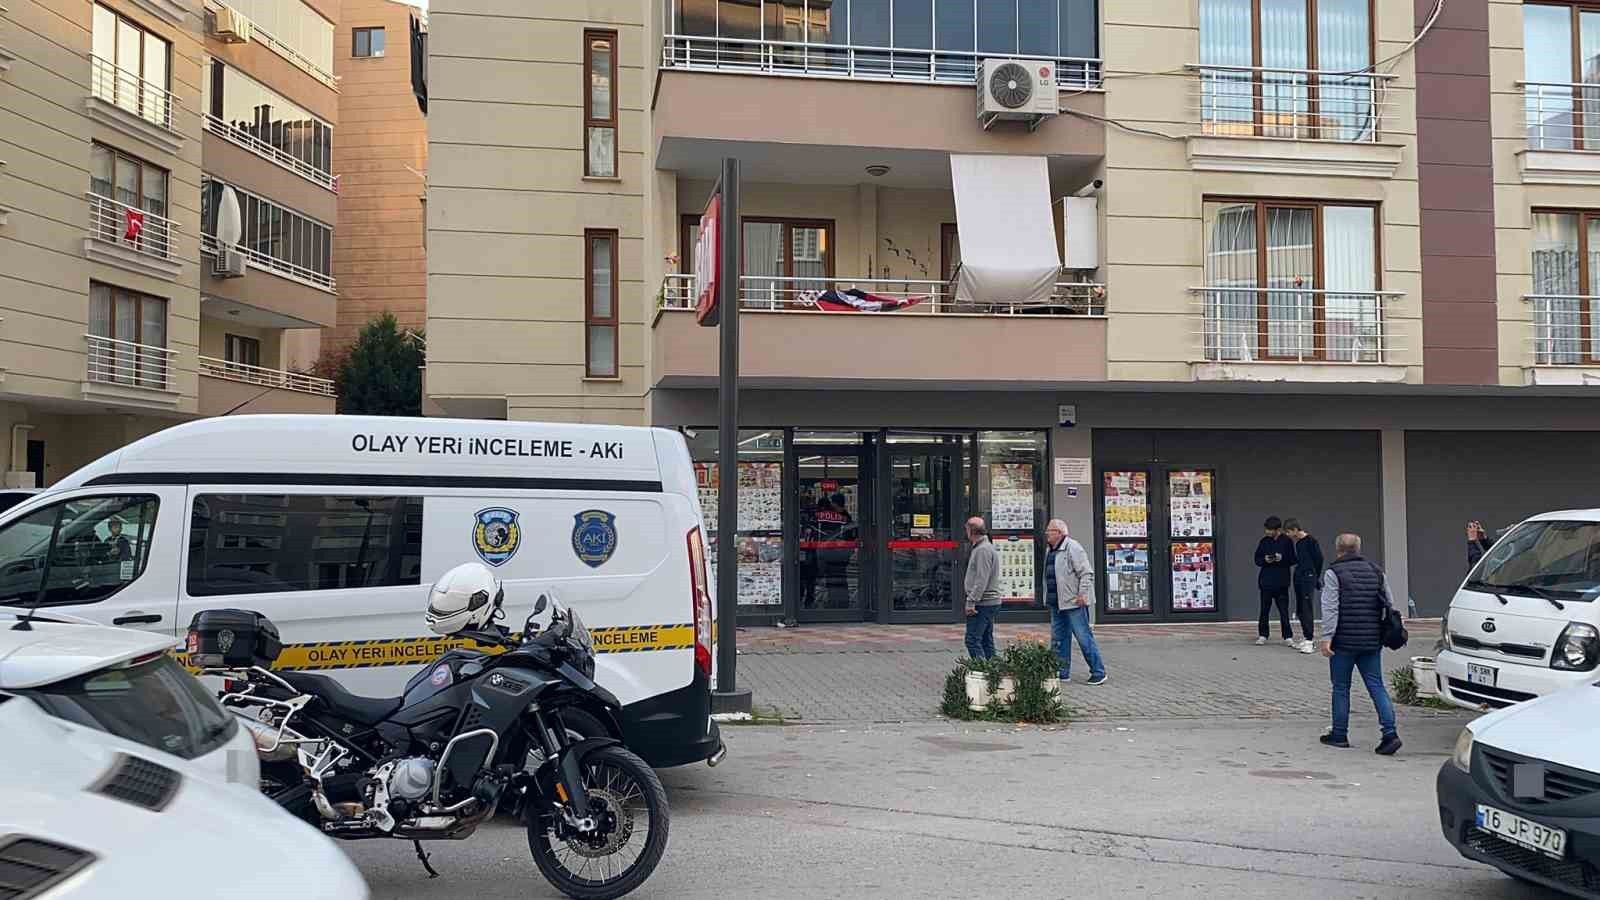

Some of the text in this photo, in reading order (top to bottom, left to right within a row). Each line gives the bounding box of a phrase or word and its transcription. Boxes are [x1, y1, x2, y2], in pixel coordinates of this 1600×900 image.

[352, 434, 408, 453] OLAY
[593, 631, 658, 645] NCELEME
[308, 648, 348, 662] OLAY
[1486, 808, 1501, 829] 16
[1534, 826, 1562, 850] 970
